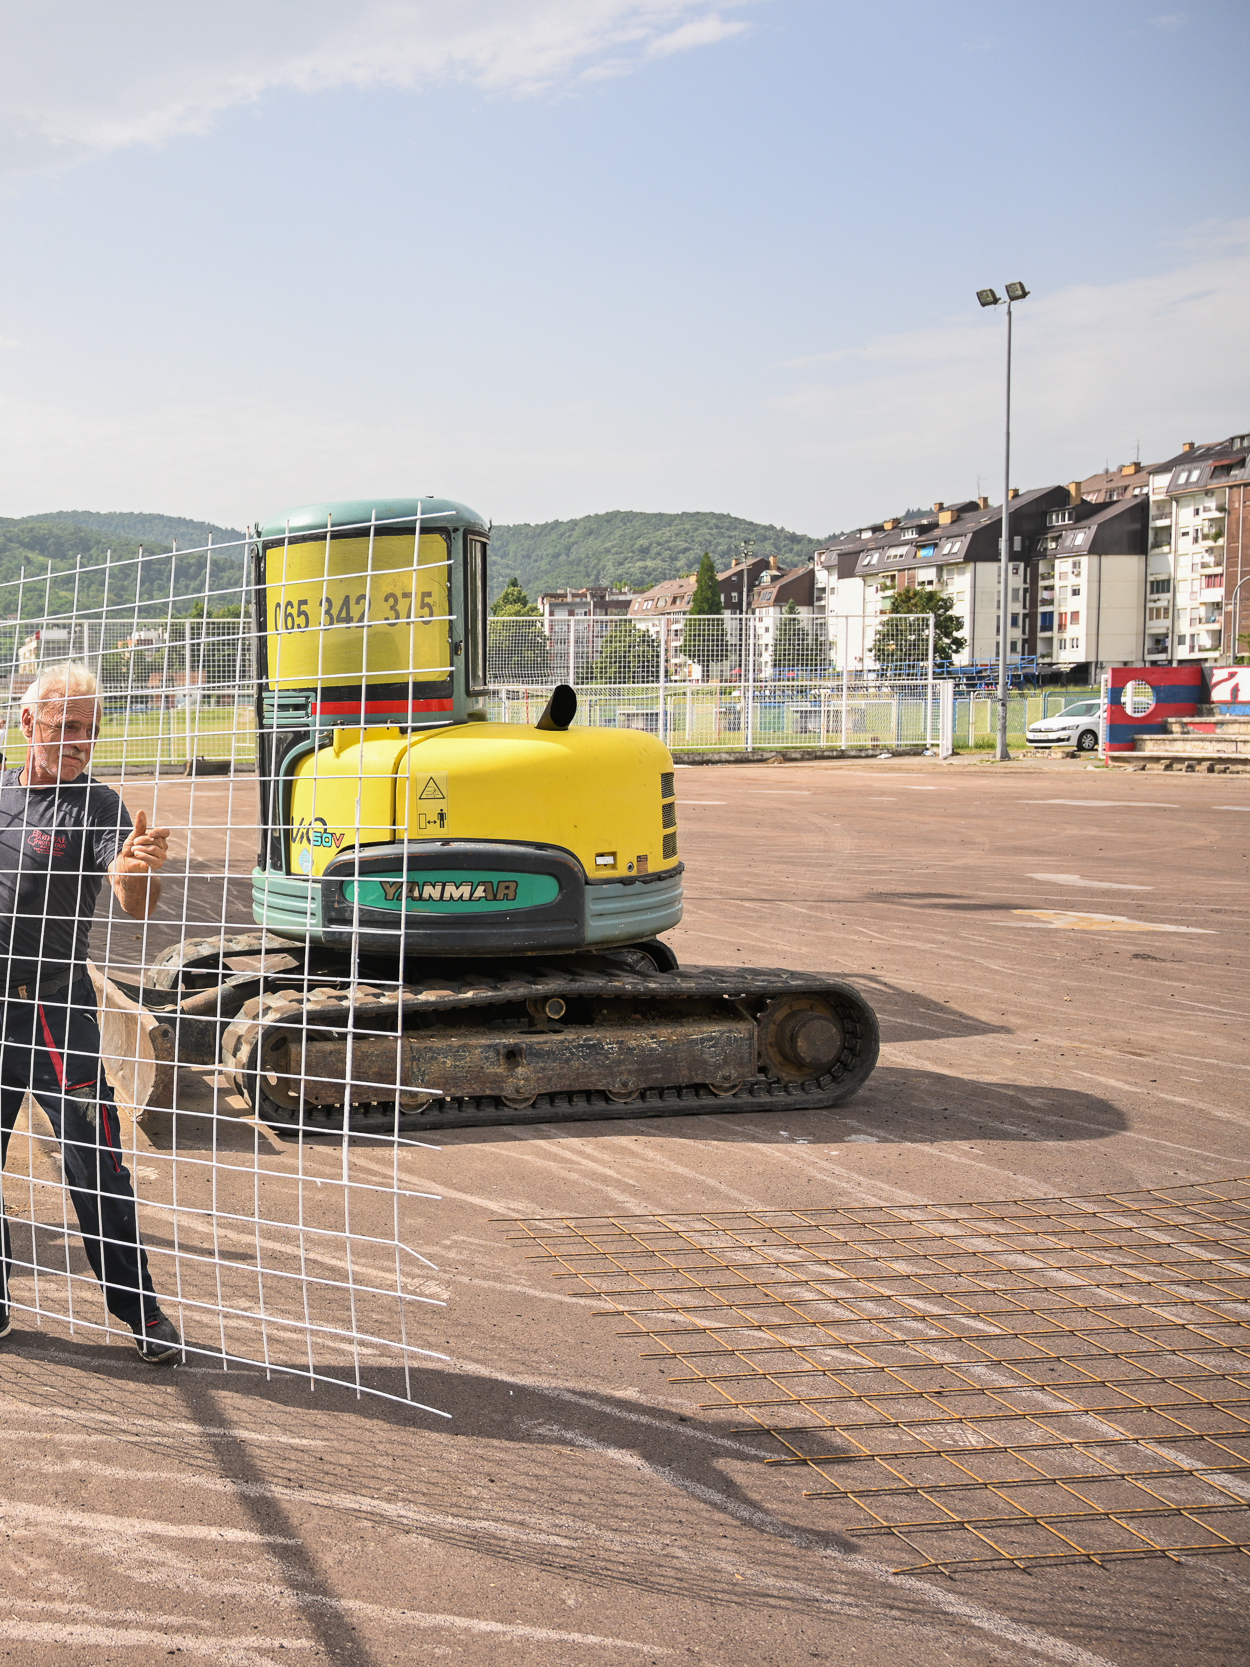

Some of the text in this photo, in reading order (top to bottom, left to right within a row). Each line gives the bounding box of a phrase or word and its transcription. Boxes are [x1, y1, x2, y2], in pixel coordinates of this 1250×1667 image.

[274, 591, 434, 635] 065 342 375
[380, 880, 518, 901] YANMAR
